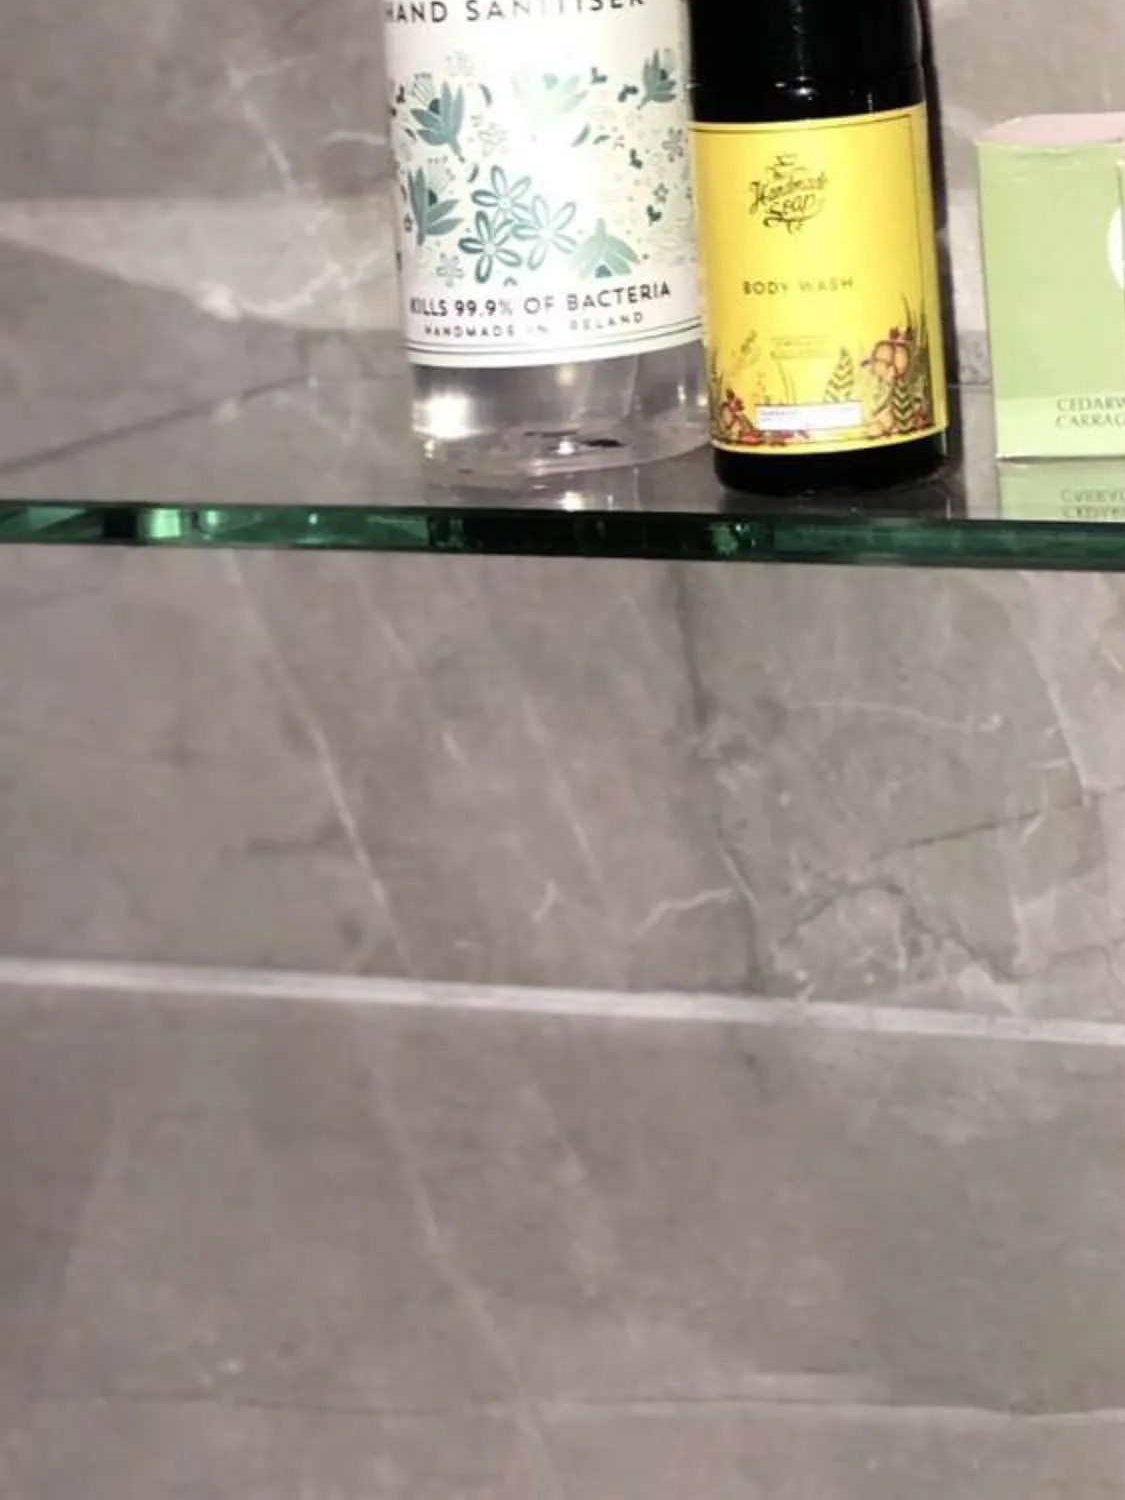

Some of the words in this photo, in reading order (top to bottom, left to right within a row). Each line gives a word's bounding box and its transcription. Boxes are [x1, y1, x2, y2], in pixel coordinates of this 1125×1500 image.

[384, 0, 448, 24] HAND
[743, 280, 789, 296] BODY
[799, 275, 854, 293] WASH
[410, 297, 447, 317] KILLS
[455, 298, 514, 318] 99.9%
[523, 295, 554, 316] OF
[567, 280, 673, 312] BACTERIA
[424, 323, 515, 338] HANDMADE
